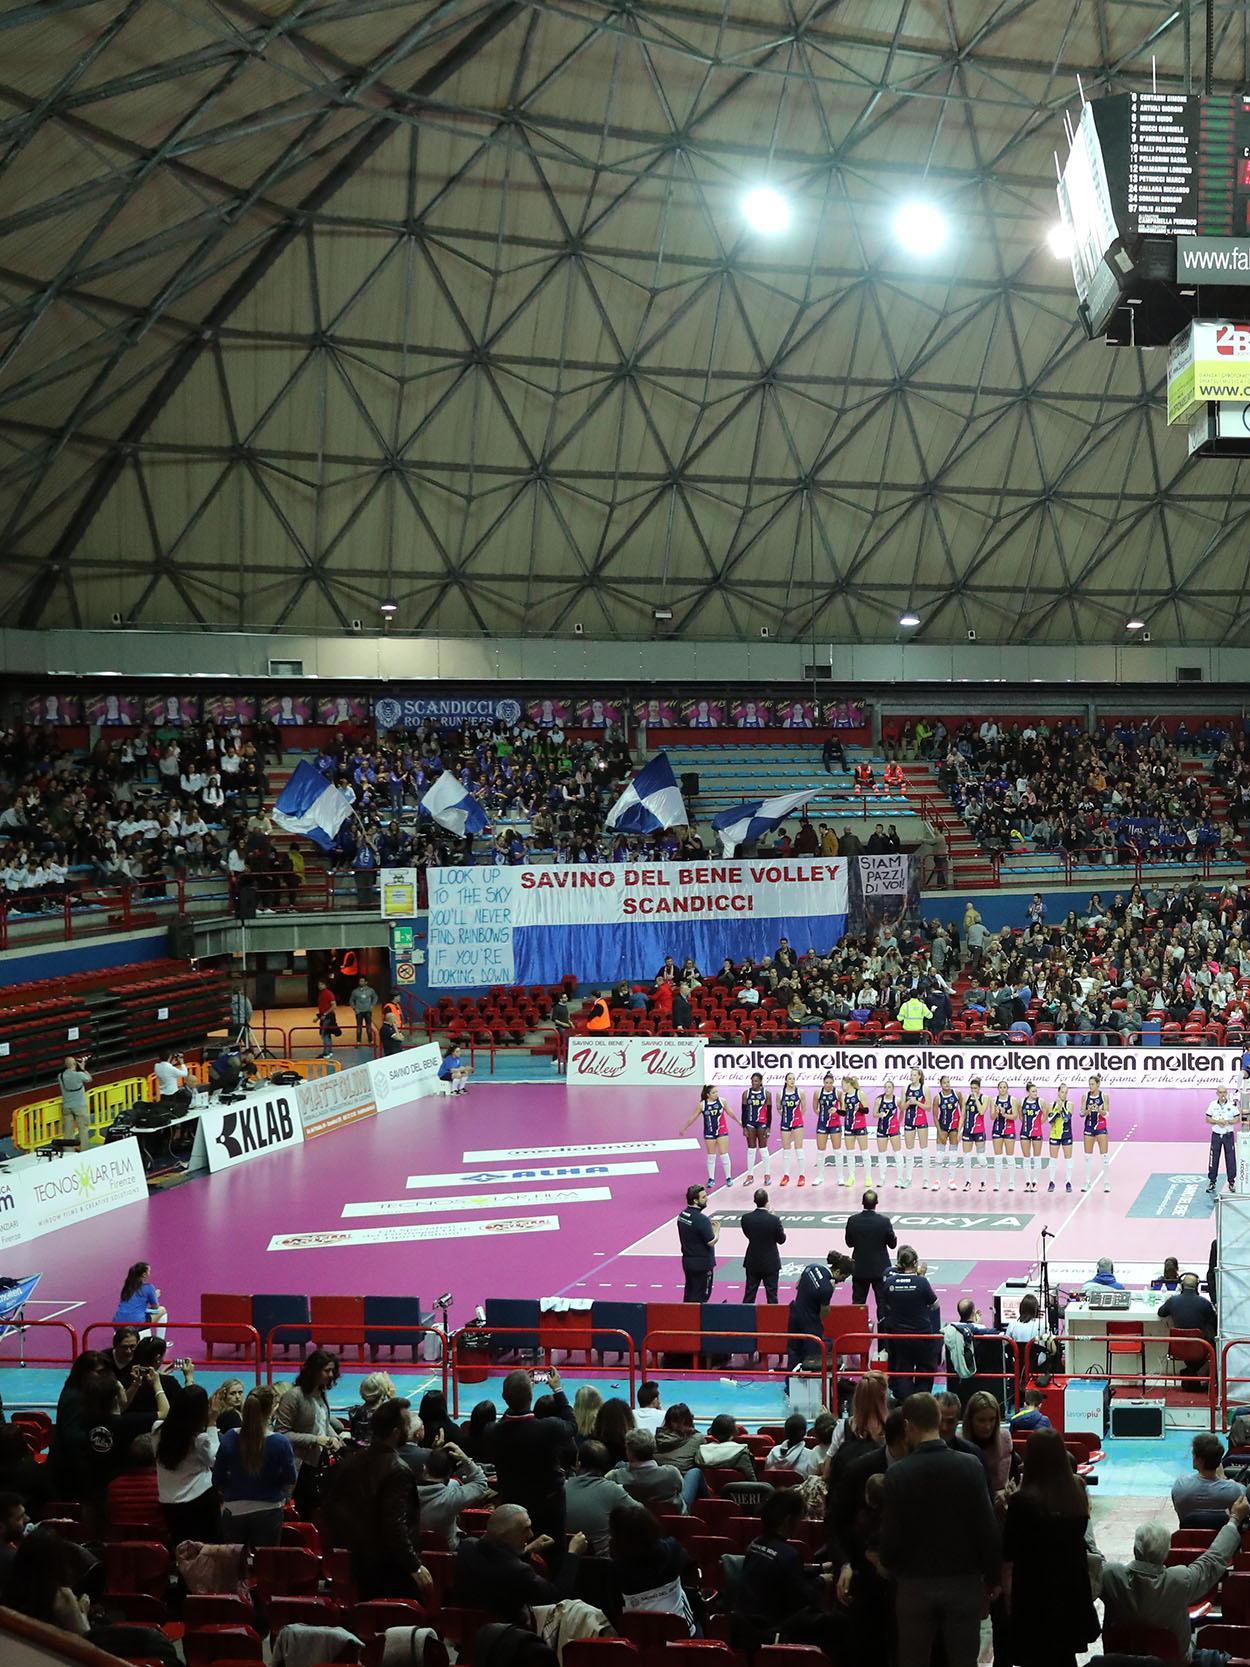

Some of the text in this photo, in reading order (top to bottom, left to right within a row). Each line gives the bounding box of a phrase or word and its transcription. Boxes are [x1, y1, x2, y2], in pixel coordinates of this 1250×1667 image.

[404, 700, 493, 714] SCANDICCI
[861, 856, 901, 869] SIAM
[439, 868, 500, 885] LOOK UP
[520, 864, 839, 889] SAVINO DEL BENE VOLLEY
[867, 869, 903, 882] PAZZI
[434, 886, 513, 905] TO THE SKY
[866, 884, 878, 893] DI
[430, 908, 512, 926] YOU'LL NEVER
[430, 927, 510, 945] FIND RAINBOWS
[435, 948, 502, 965] IF YOU'RE
[431, 968, 510, 984] LOOKING DOWN
[572, 1048, 622, 1077] Volley
[641, 1048, 691, 1077] Volley
[714, 1051, 793, 1069] molten
[800, 1051, 877, 1069] molten
[885, 1051, 963, 1070] molten
[971, 1052, 1049, 1071] molten
[1057, 1052, 1136, 1071] molten
[1144, 1053, 1224, 1071] molten
[389, 1058, 438, 1081] SAVINO DEL BENE
[1141, 1074, 1224, 1086] For the game
[239, 1098, 294, 1153] KLAB
[110, 1158, 134, 1178] FILM
[110, 1176, 136, 1190] Firenze
[38, 1214, 61, 1226] WINDOW
[86, 1198, 109, 1210] CREATIVE
